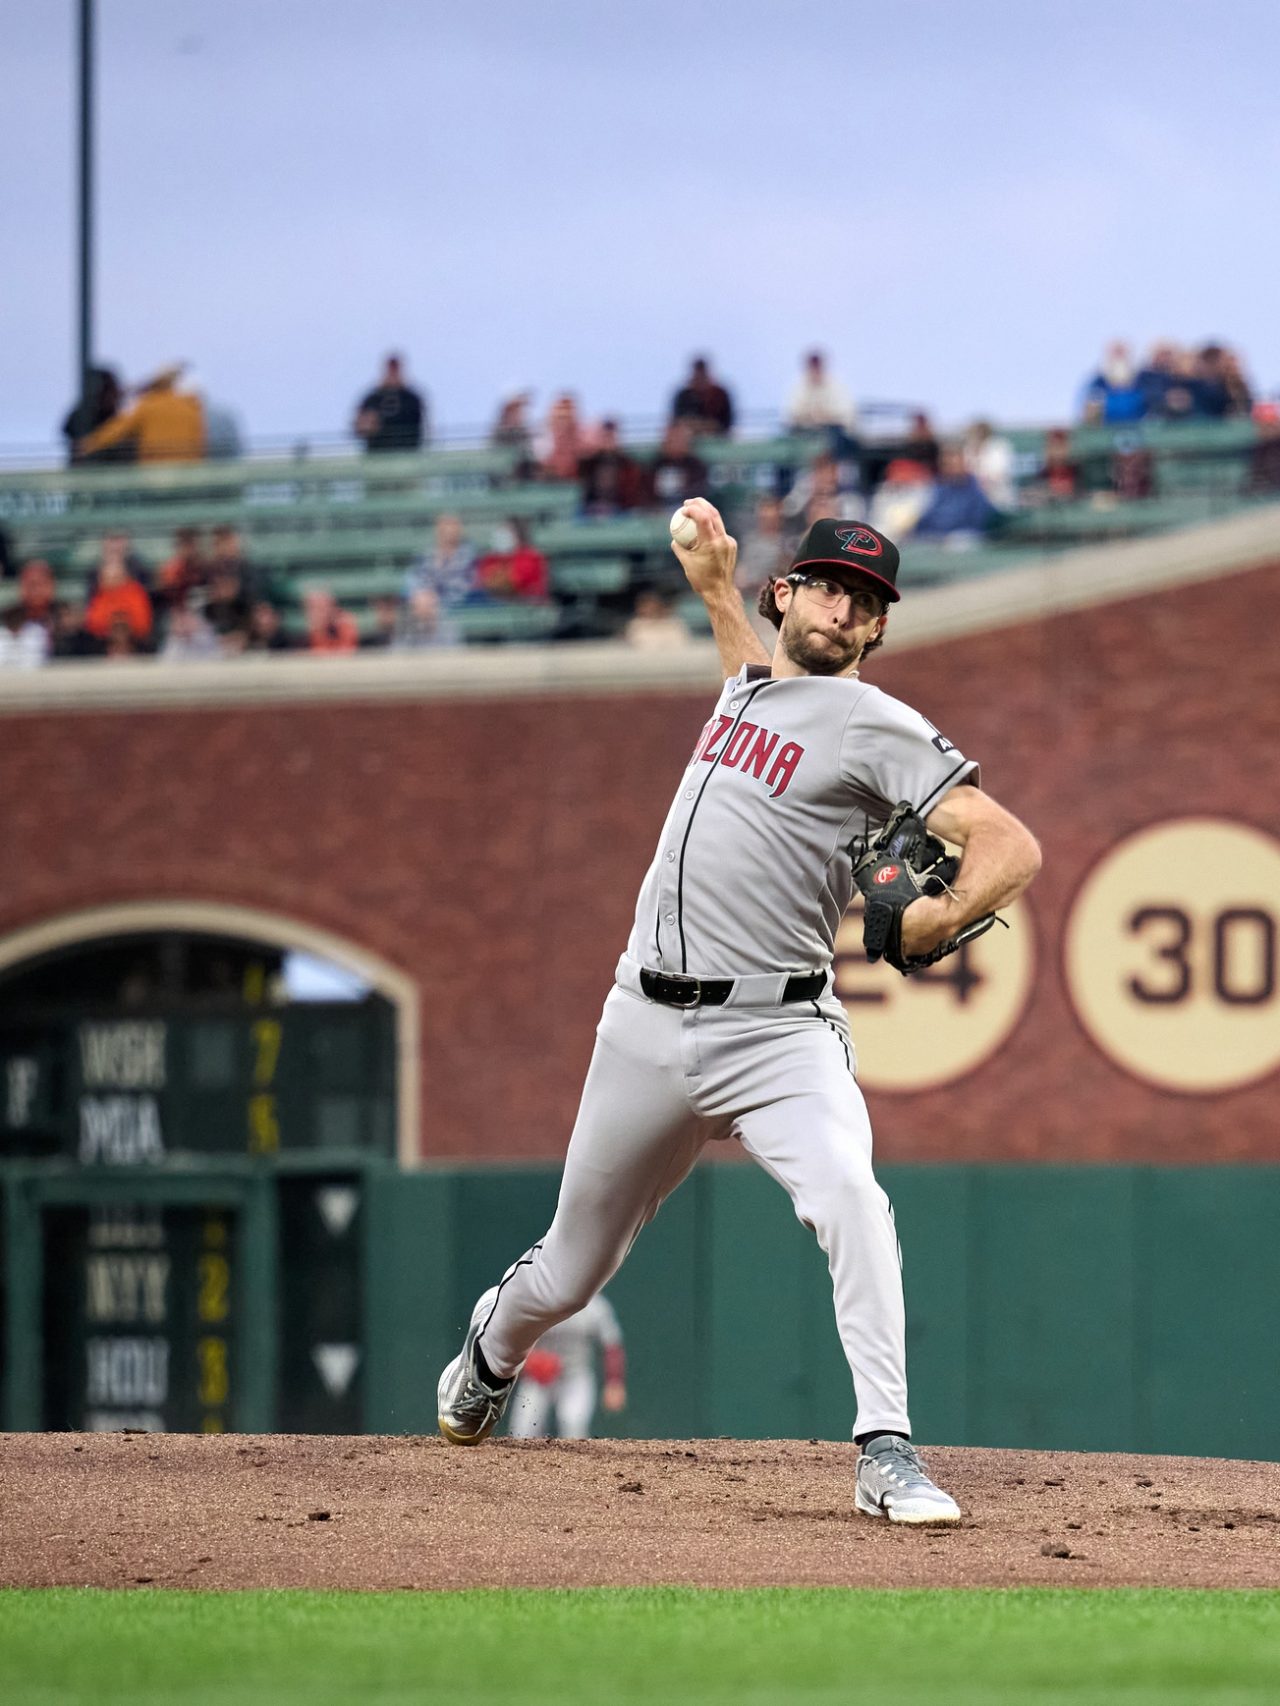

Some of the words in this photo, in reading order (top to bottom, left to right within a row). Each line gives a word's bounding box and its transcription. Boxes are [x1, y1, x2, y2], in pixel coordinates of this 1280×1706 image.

[1128, 906, 1279, 1005] 30
[254, 1019, 281, 1086] 7
[199, 1254, 229, 1323] 2
